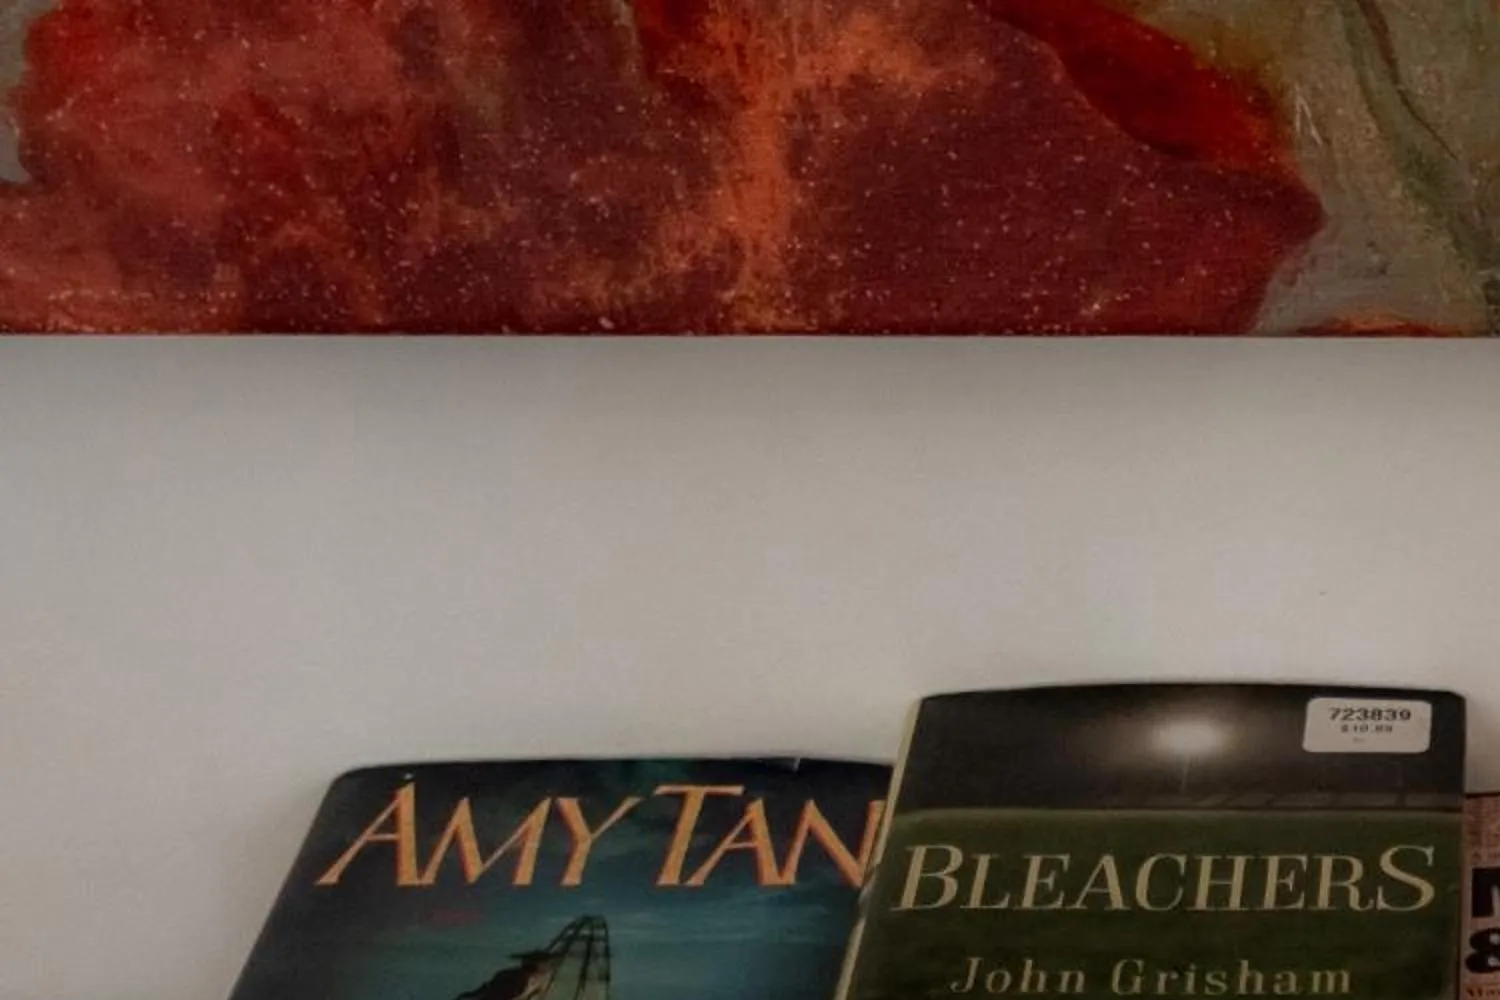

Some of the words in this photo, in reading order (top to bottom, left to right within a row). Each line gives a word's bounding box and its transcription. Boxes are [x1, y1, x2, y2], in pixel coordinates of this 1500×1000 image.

[314, 782, 642, 886] AMY
[653, 785, 887, 889] TAN
[890, 844, 1437, 912] BLEACHERS
[950, 956, 1086, 994] John
[1111, 959, 1352, 995] Grisham
